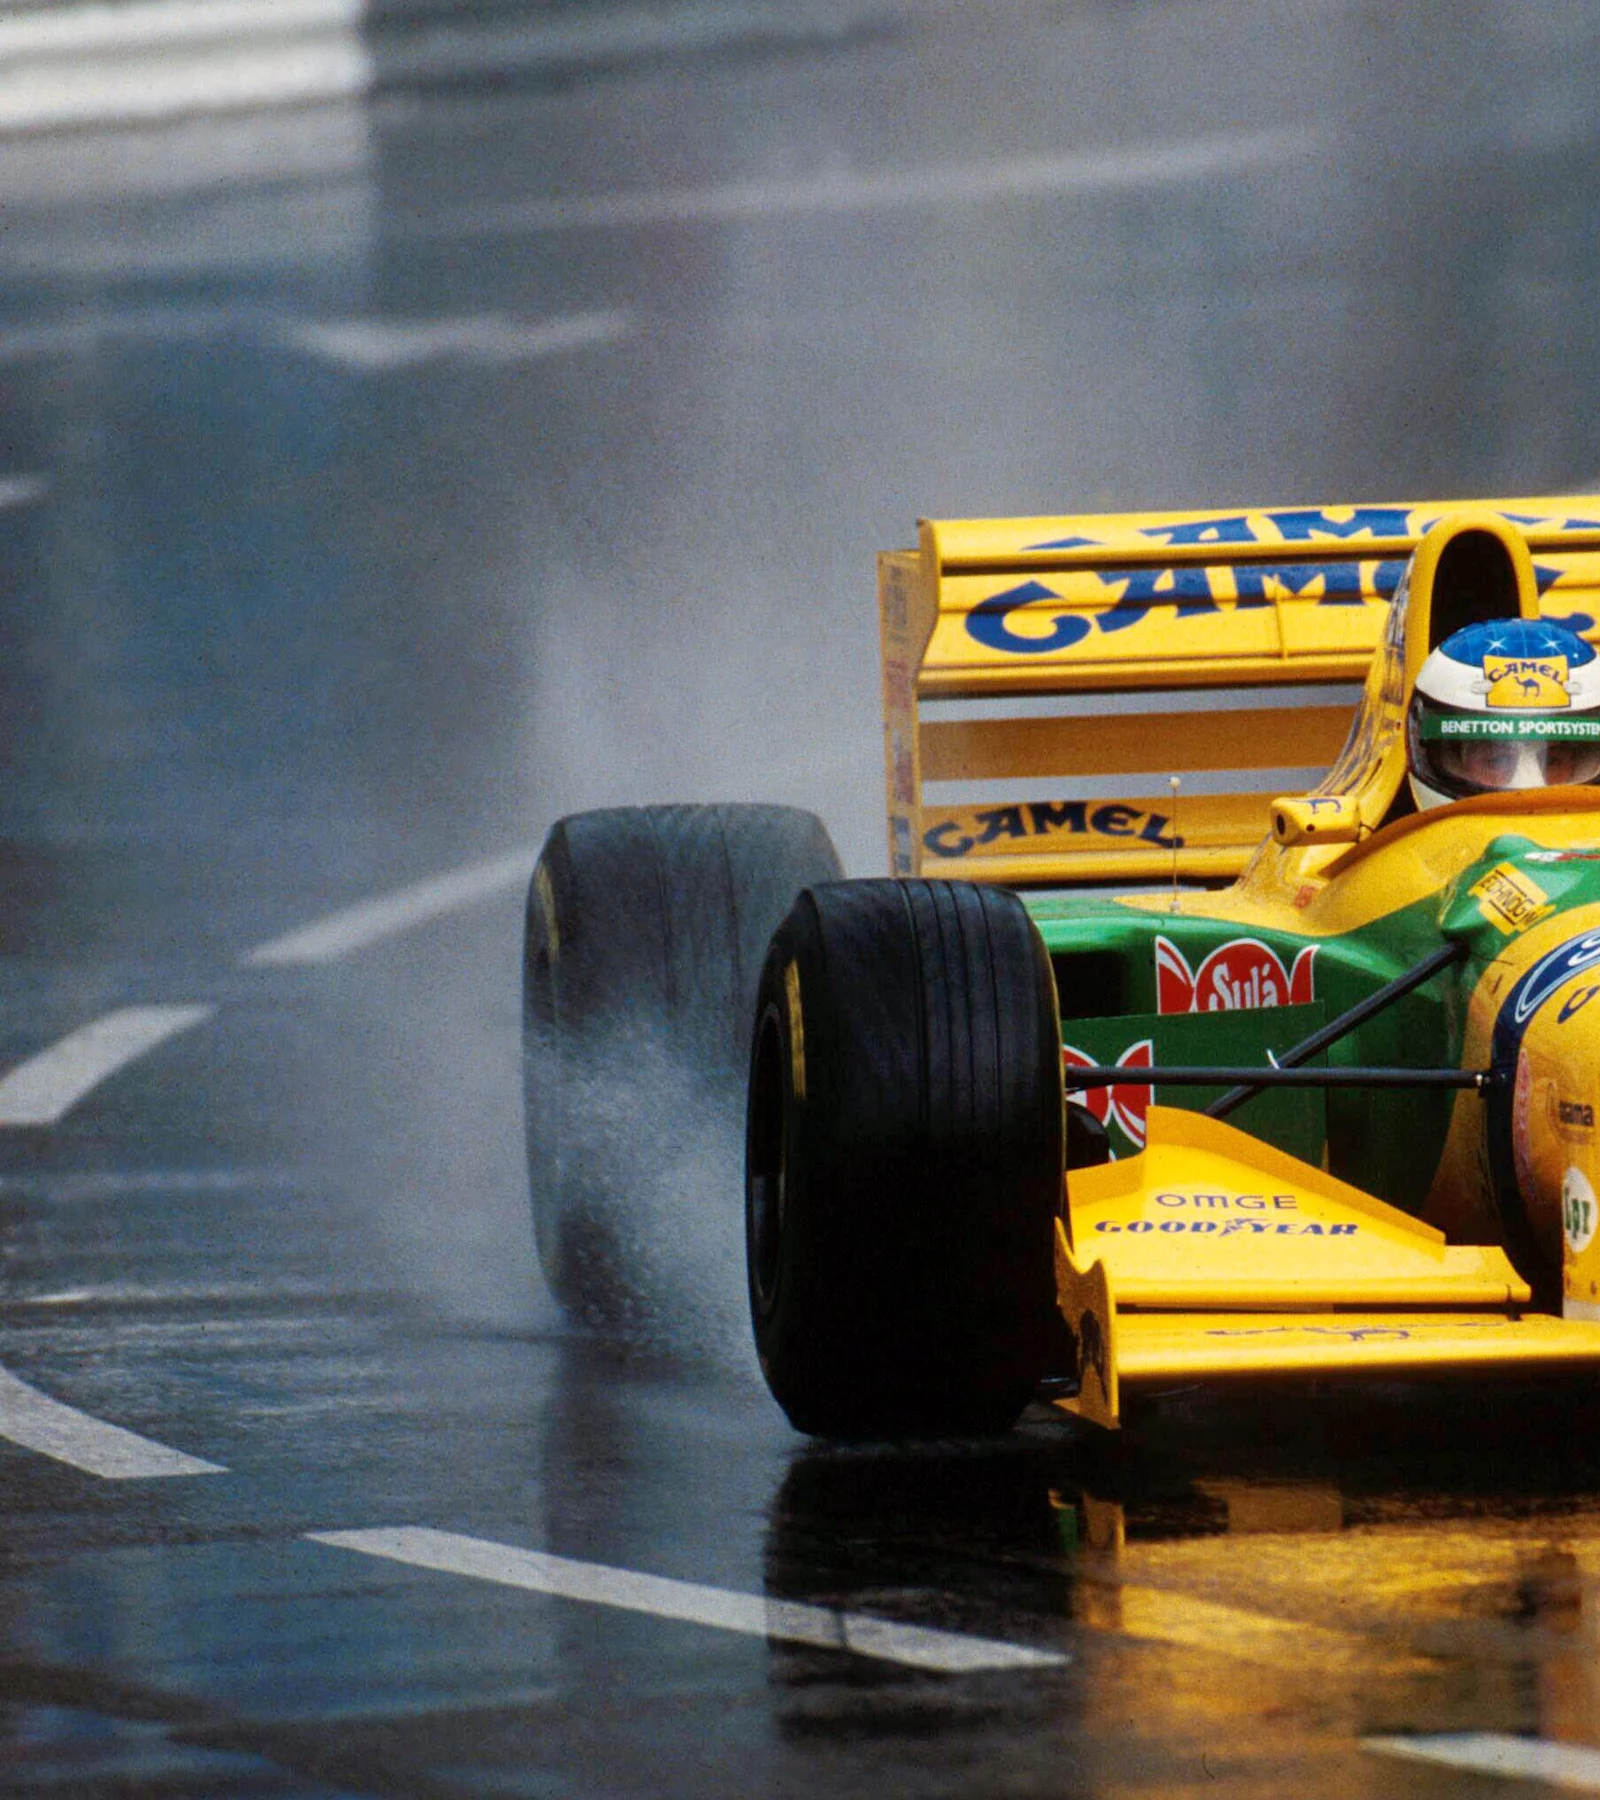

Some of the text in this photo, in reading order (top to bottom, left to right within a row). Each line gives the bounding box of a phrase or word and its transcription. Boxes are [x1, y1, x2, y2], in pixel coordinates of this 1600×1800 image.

[1487, 660, 1565, 685] CAMEL
[1440, 719, 1514, 735] BENETTON
[922, 800, 1186, 858] CAMEL
